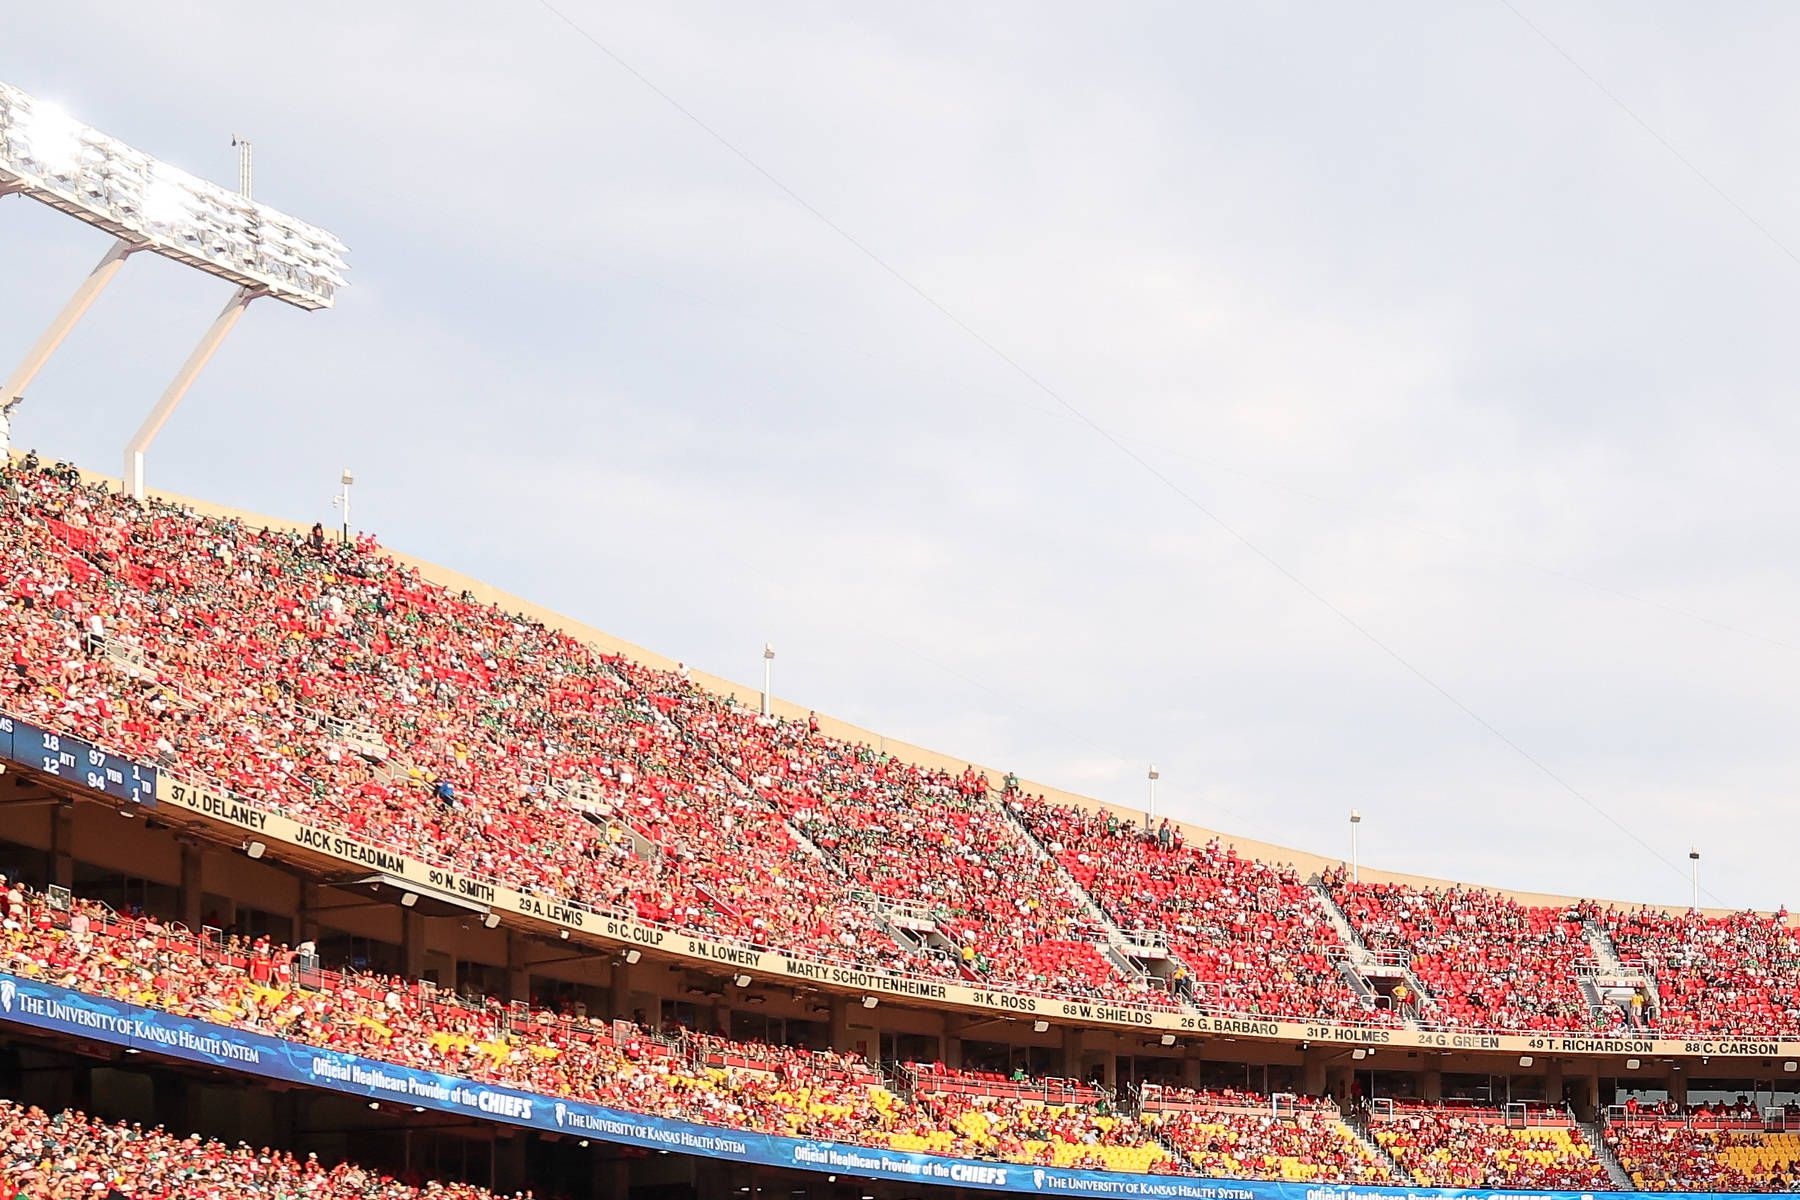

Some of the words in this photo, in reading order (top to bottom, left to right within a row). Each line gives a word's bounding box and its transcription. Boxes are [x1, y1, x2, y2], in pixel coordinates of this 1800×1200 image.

[43, 733, 59, 751] 18
[60, 752, 75, 768] ATT
[89, 750, 105, 768] 97
[132, 766, 140, 780] 1
[43, 757, 59, 775] 12
[88, 772, 105, 790] 94
[132, 788, 140, 802] 1
[172, 786, 184, 800] 37
[188, 791, 200, 808] J.
[203, 795, 267, 829] DELANEY
[295, 826, 331, 852] JACK
[334, 839, 404, 874] STEADMAN
[429, 870, 443, 883] 90
[445, 874, 456, 889] N.
[459, 879, 494, 902] SMITH
[519, 898, 532, 911] 29
[533, 902, 544, 916] A.
[547, 904, 582, 926] LEWIS
[607, 922, 618, 934] 61
[619, 924, 631, 939] C.
[633, 926, 663, 946] CULP
[689, 941, 695, 953] 8
[698, 944, 709, 958] N.
[712, 947, 760, 966] LOWERY
[786, 961, 829, 979] MARTY
[832, 968, 946, 999] SCHOTTENHEIMER
[973, 992, 985, 1003] 31
[986, 994, 998, 1006] K.
[1001, 996, 1036, 1011] ROSS
[1063, 1004, 1077, 1016] 68
[1079, 1005, 1094, 1018] W.
[1097, 1007, 1152, 1024] SHIELDS
[18, 993, 44, 1016] THE
[47, 1002, 116, 1030] UNIVERSITY
[117, 1019, 133, 1035] OF
[135, 1022, 177, 1045] KANSAS
[179, 1031, 220, 1054] HEALTH
[222, 1041, 259, 1063] SYSTEM
[1181, 1018, 1194, 1028] 26
[1198, 1018, 1211, 1031] G.
[1214, 1020, 1278, 1036] BARBARO
[1307, 1028, 1319, 1038] 31
[1321, 1029, 1332, 1039] P.
[1335, 1030, 1390, 1042] HOLMES
[1418, 1034, 1434, 1044] 24
[1436, 1035, 1449, 1046] G.
[1452, 1036, 1499, 1048] GREEN
[1529, 1039, 1544, 1049] 49
[1546, 1040, 1558, 1050] T.
[1562, 1039, 1653, 1052] RICHARDSON
[1685, 1043, 1699, 1052] 88
[1704, 1042, 1716, 1054] C.
[1719, 1043, 1778, 1055] CARSON
[313, 1057, 350, 1081] Official
[353, 1068, 407, 1092] Healthcare
[408, 1078, 449, 1100] Provider
[451, 1089, 461, 1103] of
[462, 1089, 477, 1106] the
[479, 1091, 532, 1119] CHIEFS
[567, 1112, 585, 1129] THE
[586, 1117, 636, 1136] UNIVERSITY
[637, 1128, 648, 1138] OF
[648, 1128, 680, 1144] KANSAS
[682, 1134, 714, 1149] HEALTH
[715, 1140, 745, 1153] SYSTEM
[795, 1146, 828, 1163] Official
[830, 1152, 880, 1170] Healthcare
[882, 1157, 920, 1174] Provider
[922, 1163, 932, 1176] of
[933, 1164, 949, 1178] the
[951, 1164, 1007, 1184] CHIEFS
[1046, 1177, 1067, 1189] THE
[1068, 1178, 1124, 1193] UNIVERSITY
[1126, 1184, 1140, 1194] OF
[1140, 1183, 1176, 1196] KANSAS
[1178, 1186, 1216, 1198] HEALTH
[1218, 1189, 1253, 1200] SYSTEM
